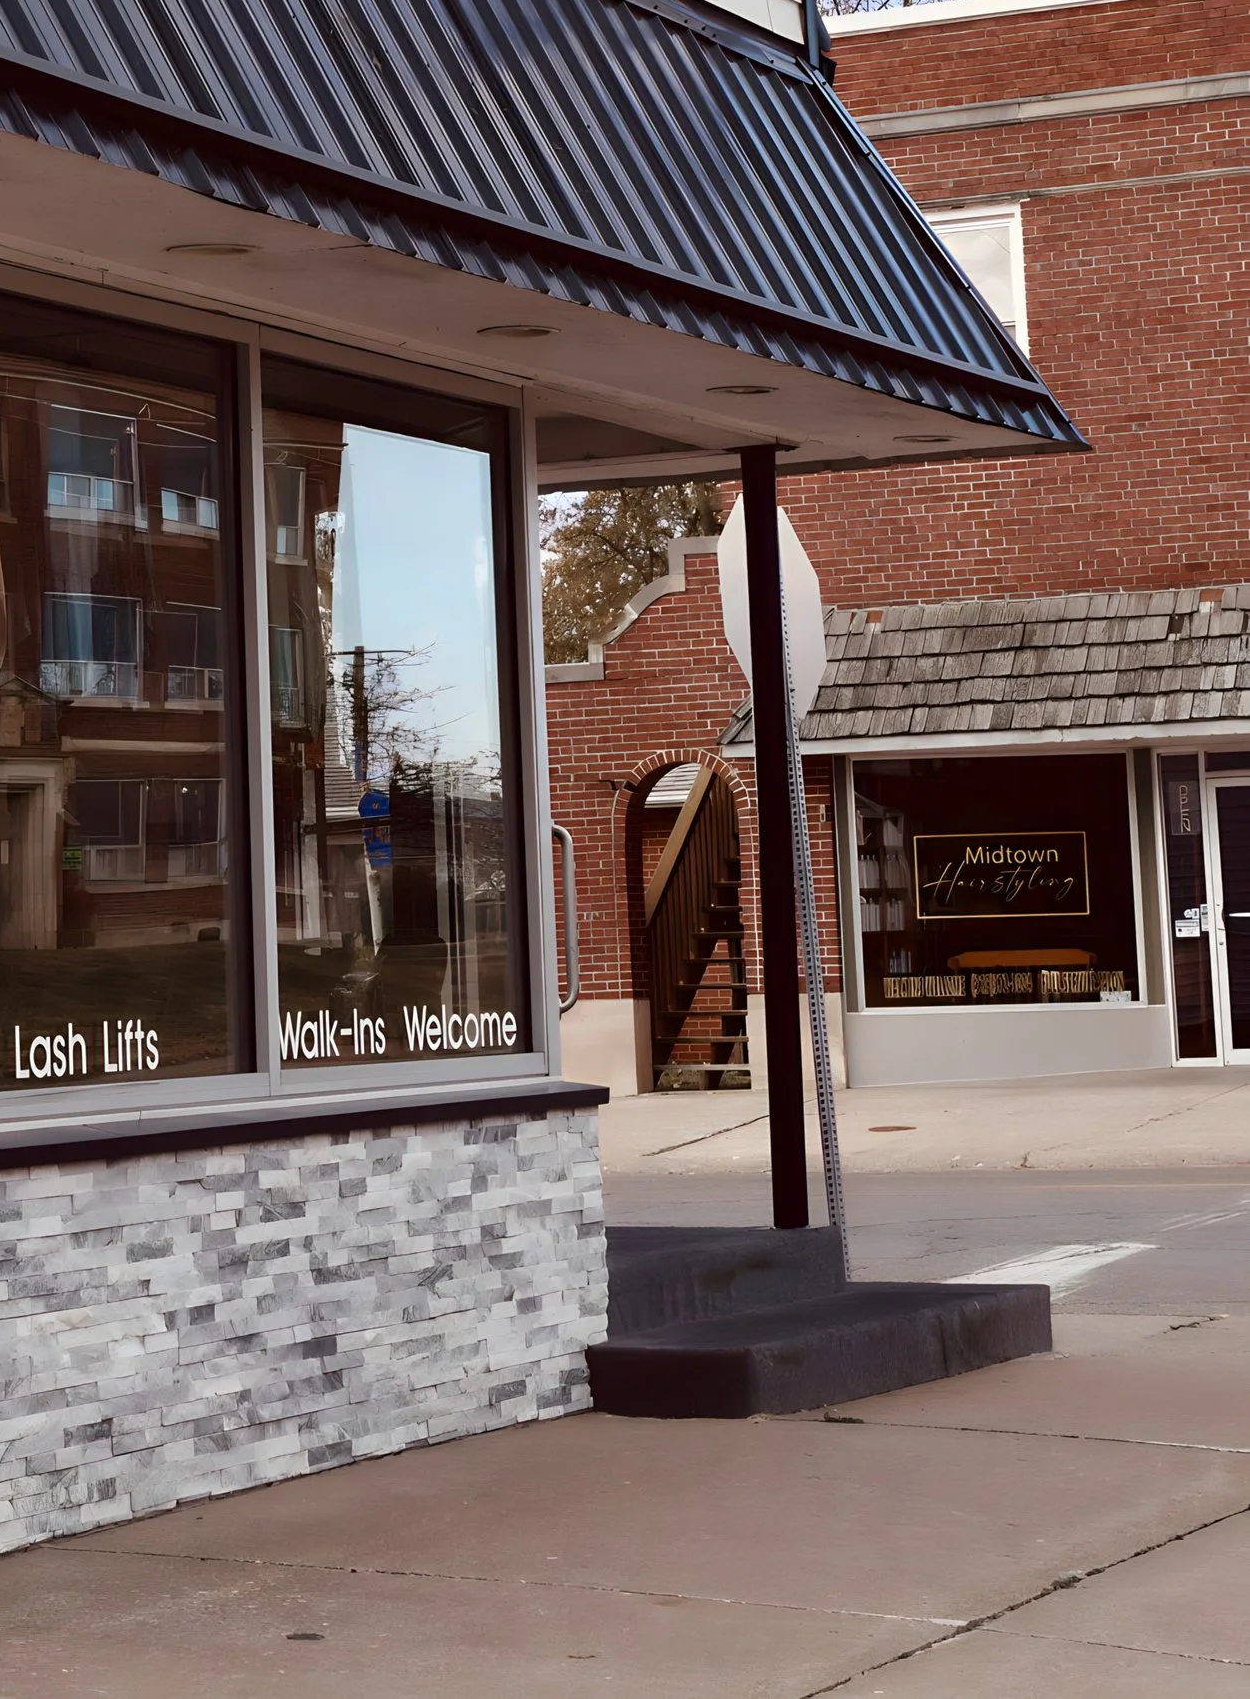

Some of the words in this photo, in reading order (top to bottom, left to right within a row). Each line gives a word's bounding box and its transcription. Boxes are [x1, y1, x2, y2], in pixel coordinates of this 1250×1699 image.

[965, 844, 1060, 865] Midtown
[14, 1022, 88, 1080] Lash
[102, 1018, 160, 1074] Lifts
[278, 1008, 387, 1061] Walk-Ins
[403, 1004, 518, 1053] Welcome
